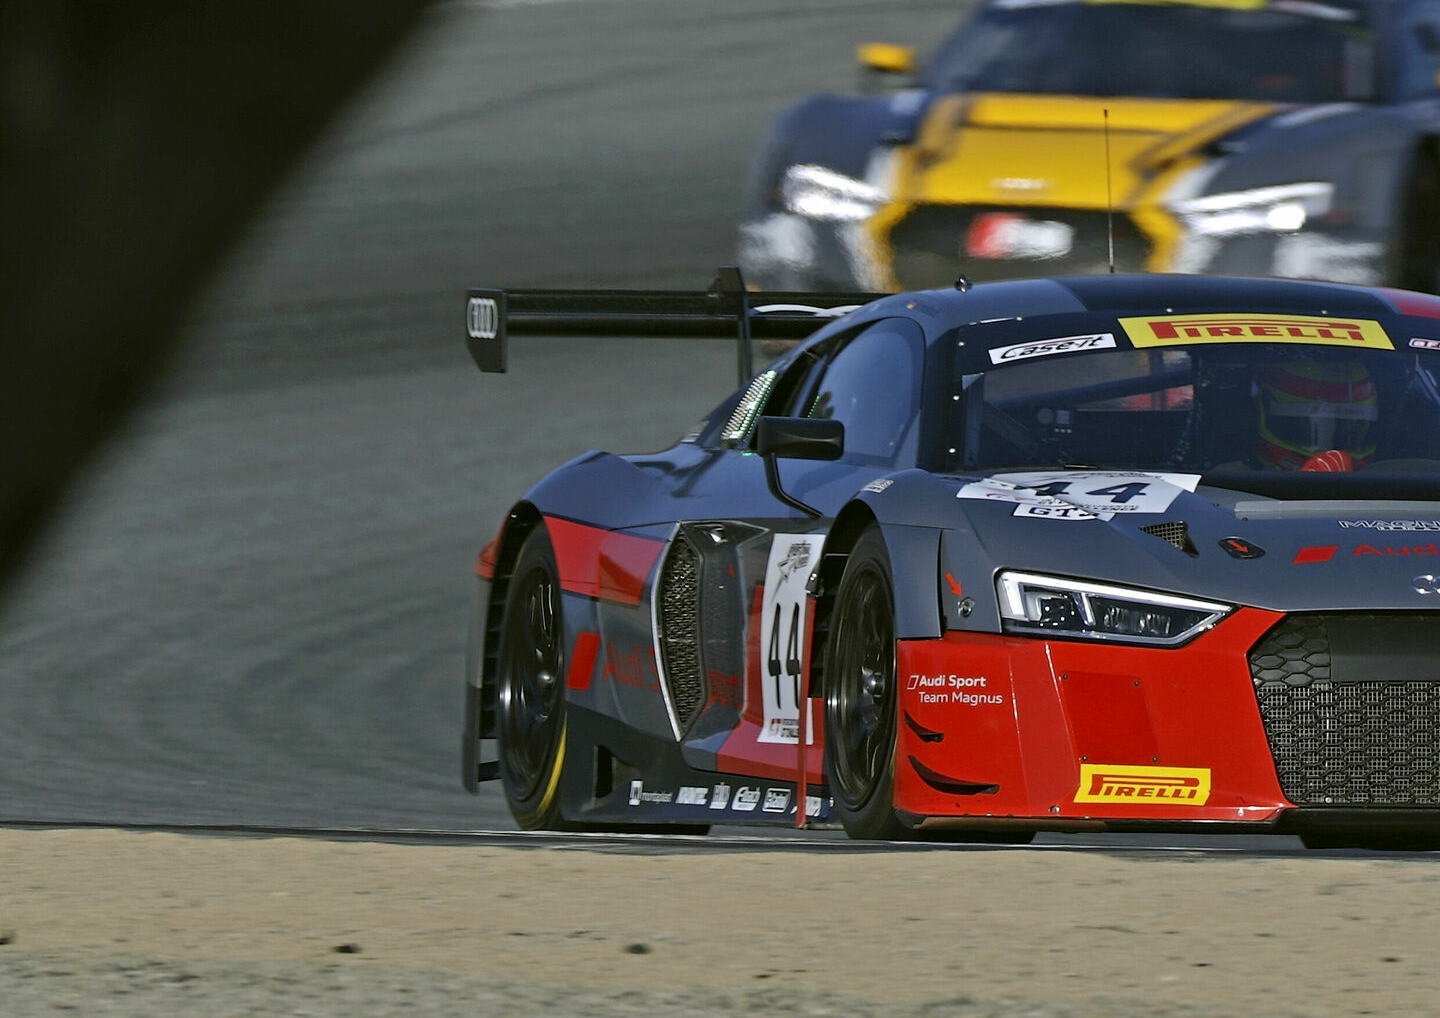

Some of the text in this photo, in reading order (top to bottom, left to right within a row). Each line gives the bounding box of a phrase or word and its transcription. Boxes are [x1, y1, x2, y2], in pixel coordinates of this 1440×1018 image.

[1148, 319, 1365, 341] PIRELLI
[769, 602, 801, 710] 44
[919, 674, 987, 689] Audi Sport
[919, 691, 1003, 706] Team Magnus
[1088, 773, 1200, 799] PIRELLI
